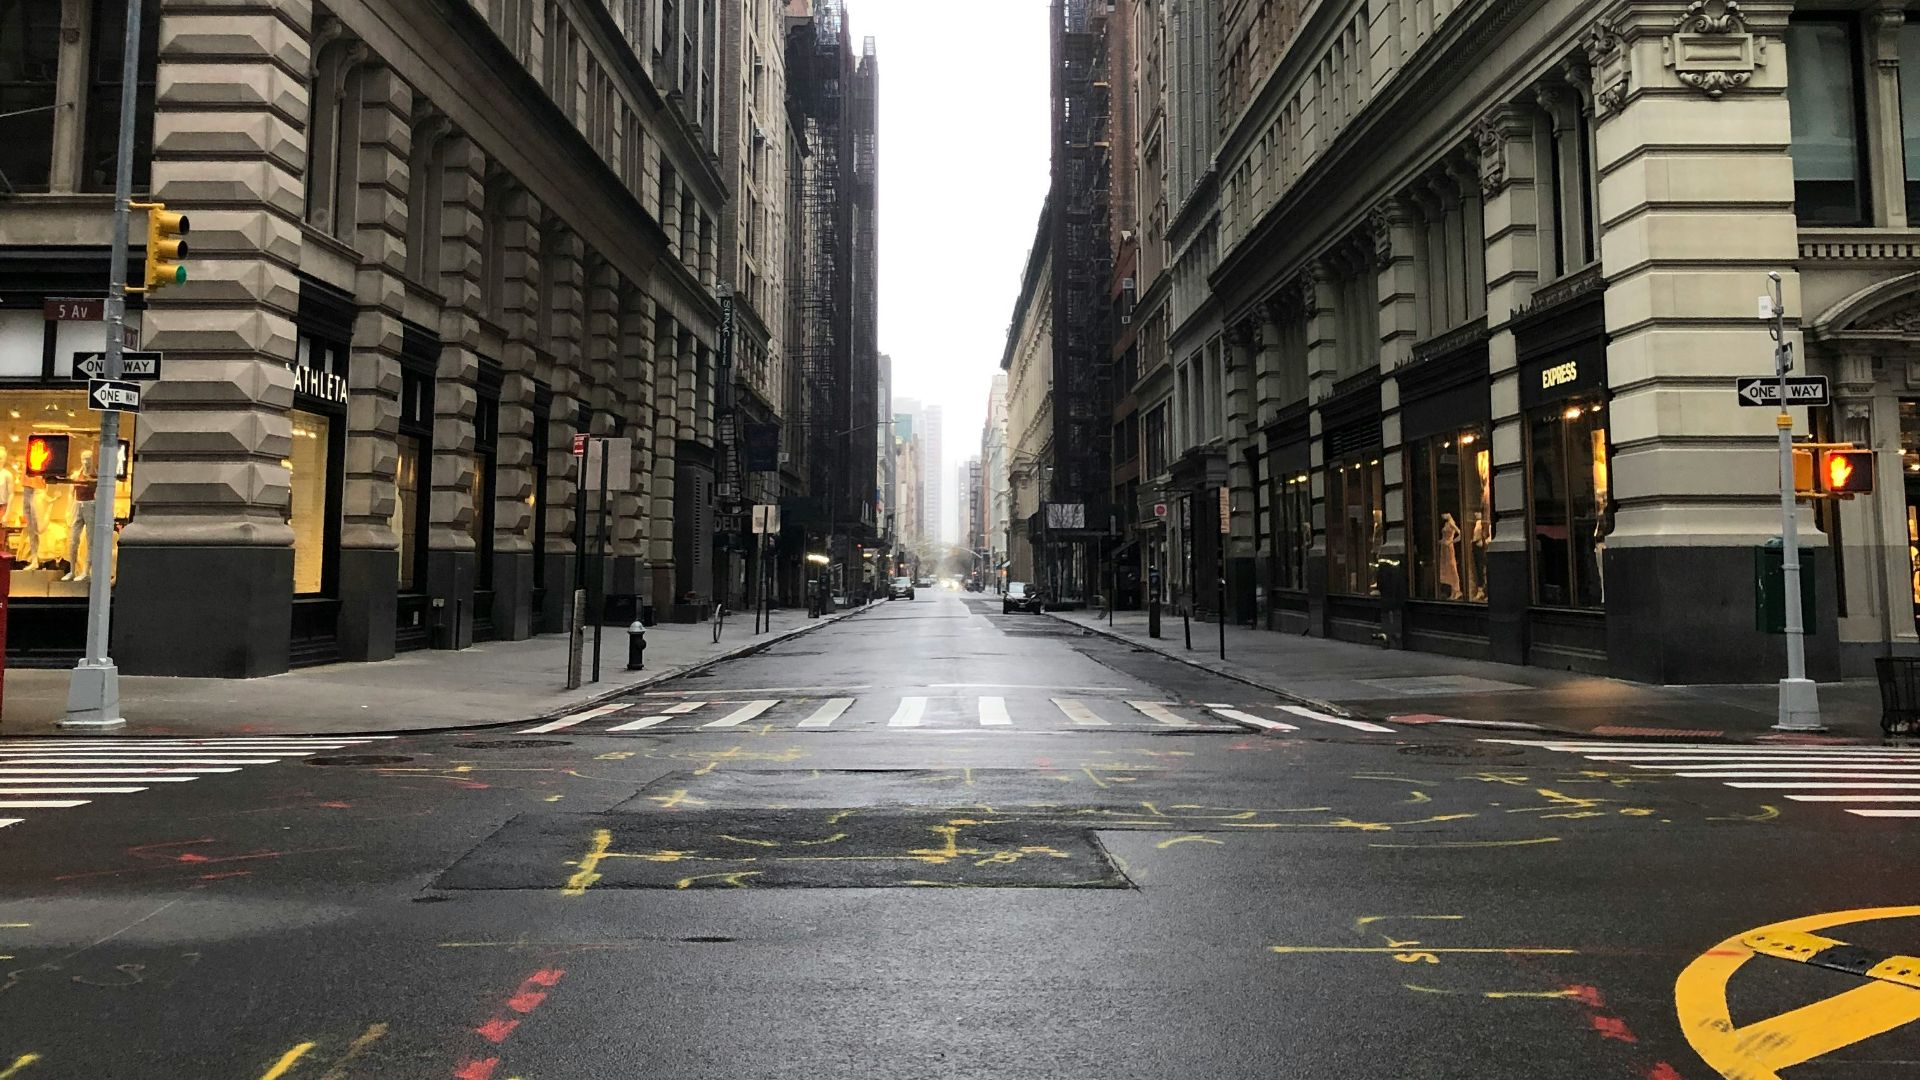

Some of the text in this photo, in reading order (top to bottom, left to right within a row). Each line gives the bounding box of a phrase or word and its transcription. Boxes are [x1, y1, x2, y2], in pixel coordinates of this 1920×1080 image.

[59, 304, 88, 318] 5 Av
[86, 361, 150, 372] ON WAY
[1542, 361, 1577, 389] EXPRESS
[293, 364, 348, 404] ATHLETA
[100, 389, 137, 404] ONE WAY
[1749, 385, 1819, 398] ONE WAY
